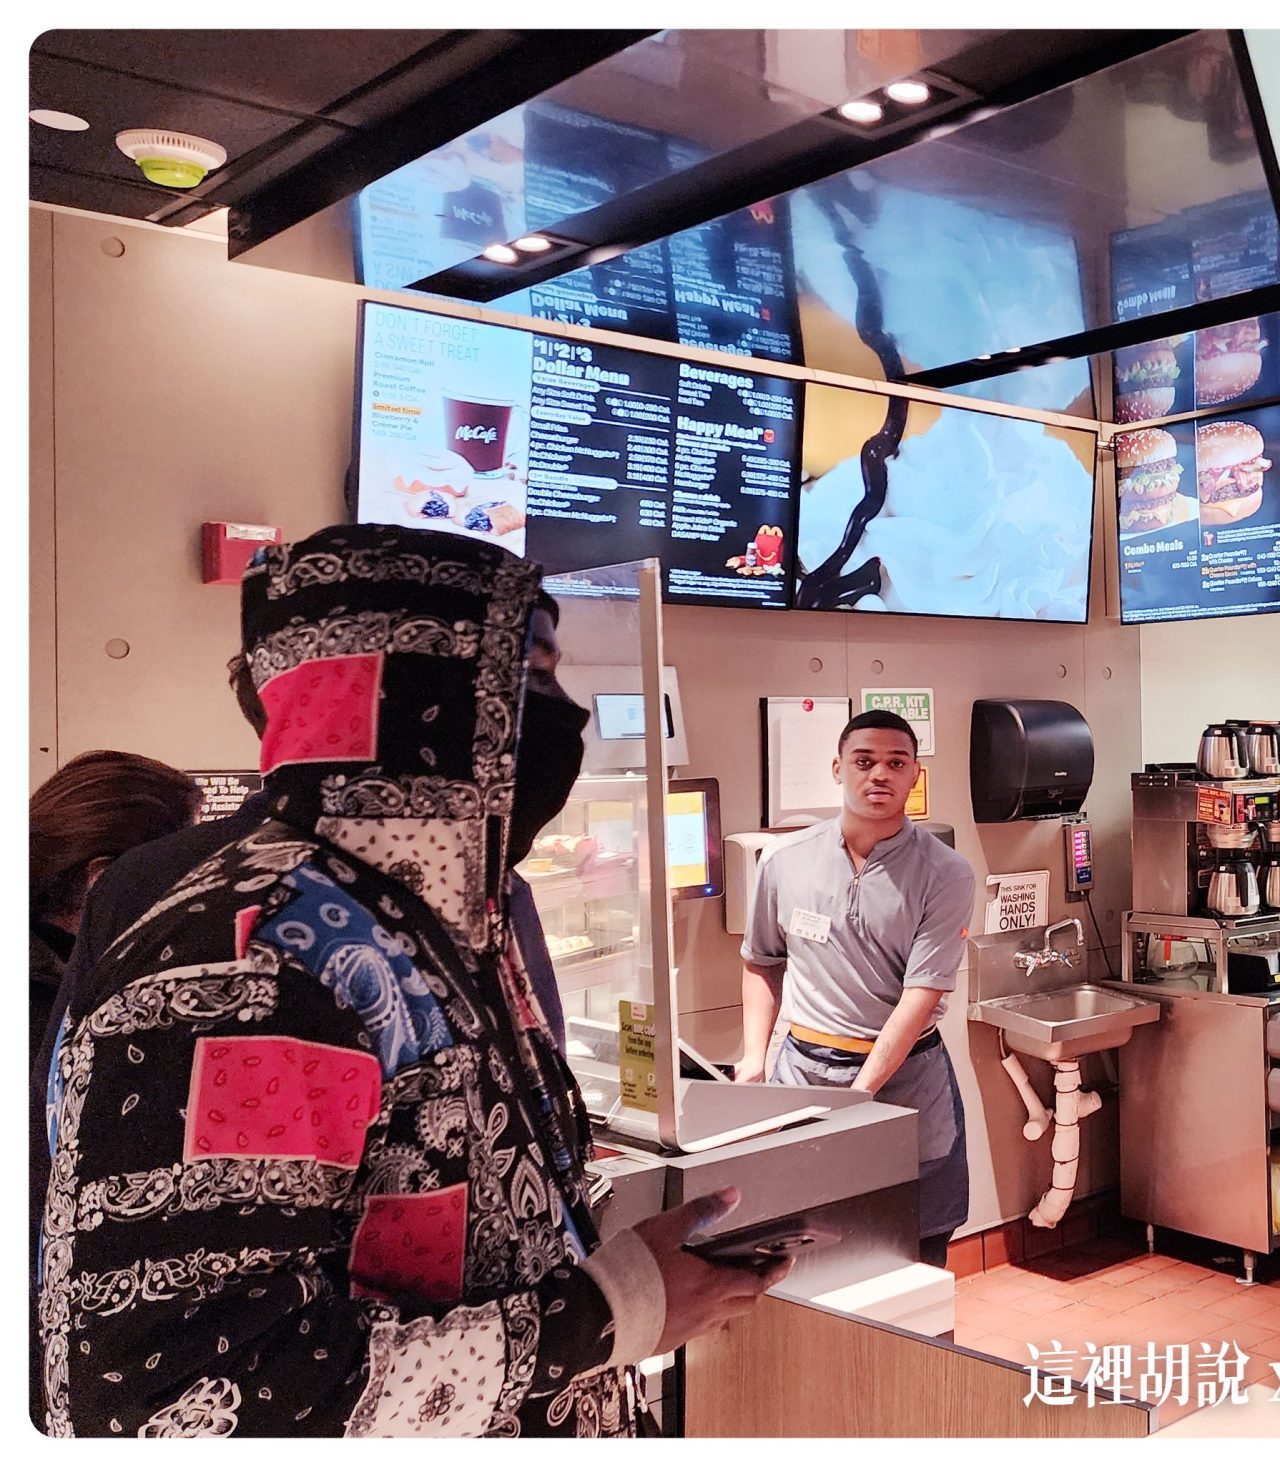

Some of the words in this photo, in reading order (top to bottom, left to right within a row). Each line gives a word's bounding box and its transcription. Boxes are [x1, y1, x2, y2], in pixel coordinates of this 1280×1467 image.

[424, 321, 478, 342] FORGET
[375, 332, 383, 347] A
[388, 333, 434, 354] SWEET
[440, 342, 480, 361] TREAT
[374, 352, 417, 363] Cinnamon
[419, 359, 435, 367] Roll
[373, 372, 410, 382] Premium
[533, 356, 584, 378] Dollar
[585, 365, 630, 386] Menu
[680, 363, 754, 390] Beverages
[399, 384, 426, 394] Coffee
[677, 415, 724, 438] Happy
[1123, 543, 1156, 557] Combo
[1156, 539, 1184, 553] Meals
[871, 695, 904, 708] C.P.R.
[906, 695, 925, 708] KIT
[210, 777, 227, 786] Will
[218, 786, 229, 794] To
[229, 785, 249, 796] Help
[1000, 892, 1036, 903] WASHING
[1000, 902, 1036, 916] HANDS
[999, 913, 1036, 930] ONLY!
